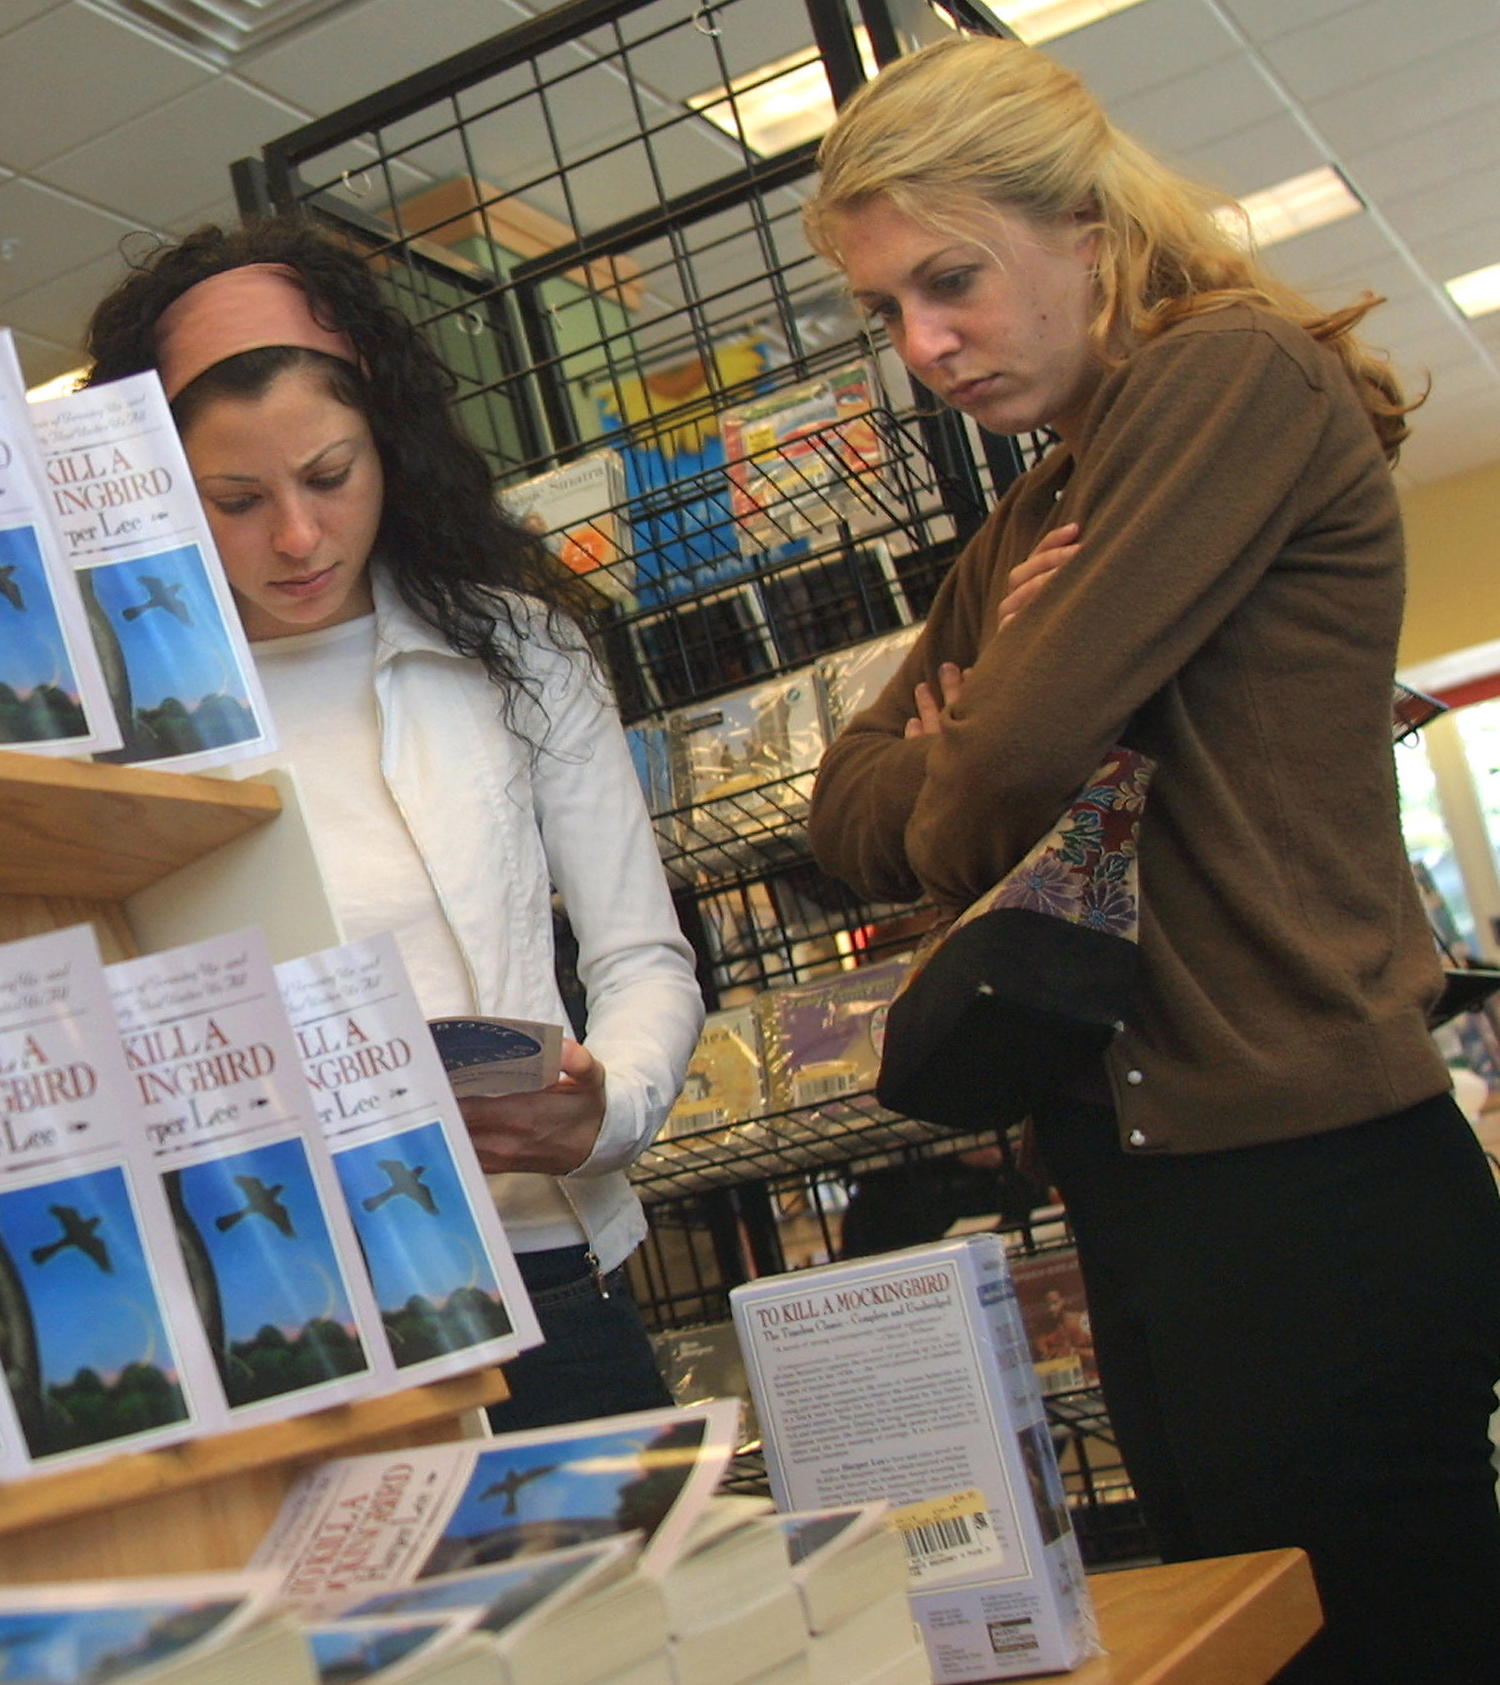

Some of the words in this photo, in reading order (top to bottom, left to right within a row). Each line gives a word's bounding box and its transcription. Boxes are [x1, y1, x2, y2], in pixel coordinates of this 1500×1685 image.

[112, 447, 133, 474] A
[53, 466, 172, 516] INGBIRD
[97, 512, 142, 538] Lee
[22, 1033, 49, 1069] A
[122, 1026, 200, 1071] KILL
[205, 1017, 230, 1051] A
[297, 1027, 341, 1060] LL
[346, 1018, 369, 1046] A
[136, 1043, 276, 1106] INGBIRD
[188, 1098, 239, 1129] Lee
[332, 1091, 380, 1118] Lee
[2, 1116, 57, 1153] Lee
[756, 1307, 780, 1329] TO
[781, 1299, 819, 1324] KILL
[823, 1296, 835, 1316] A
[835, 1272, 950, 1313] MOCKINGBIRD
